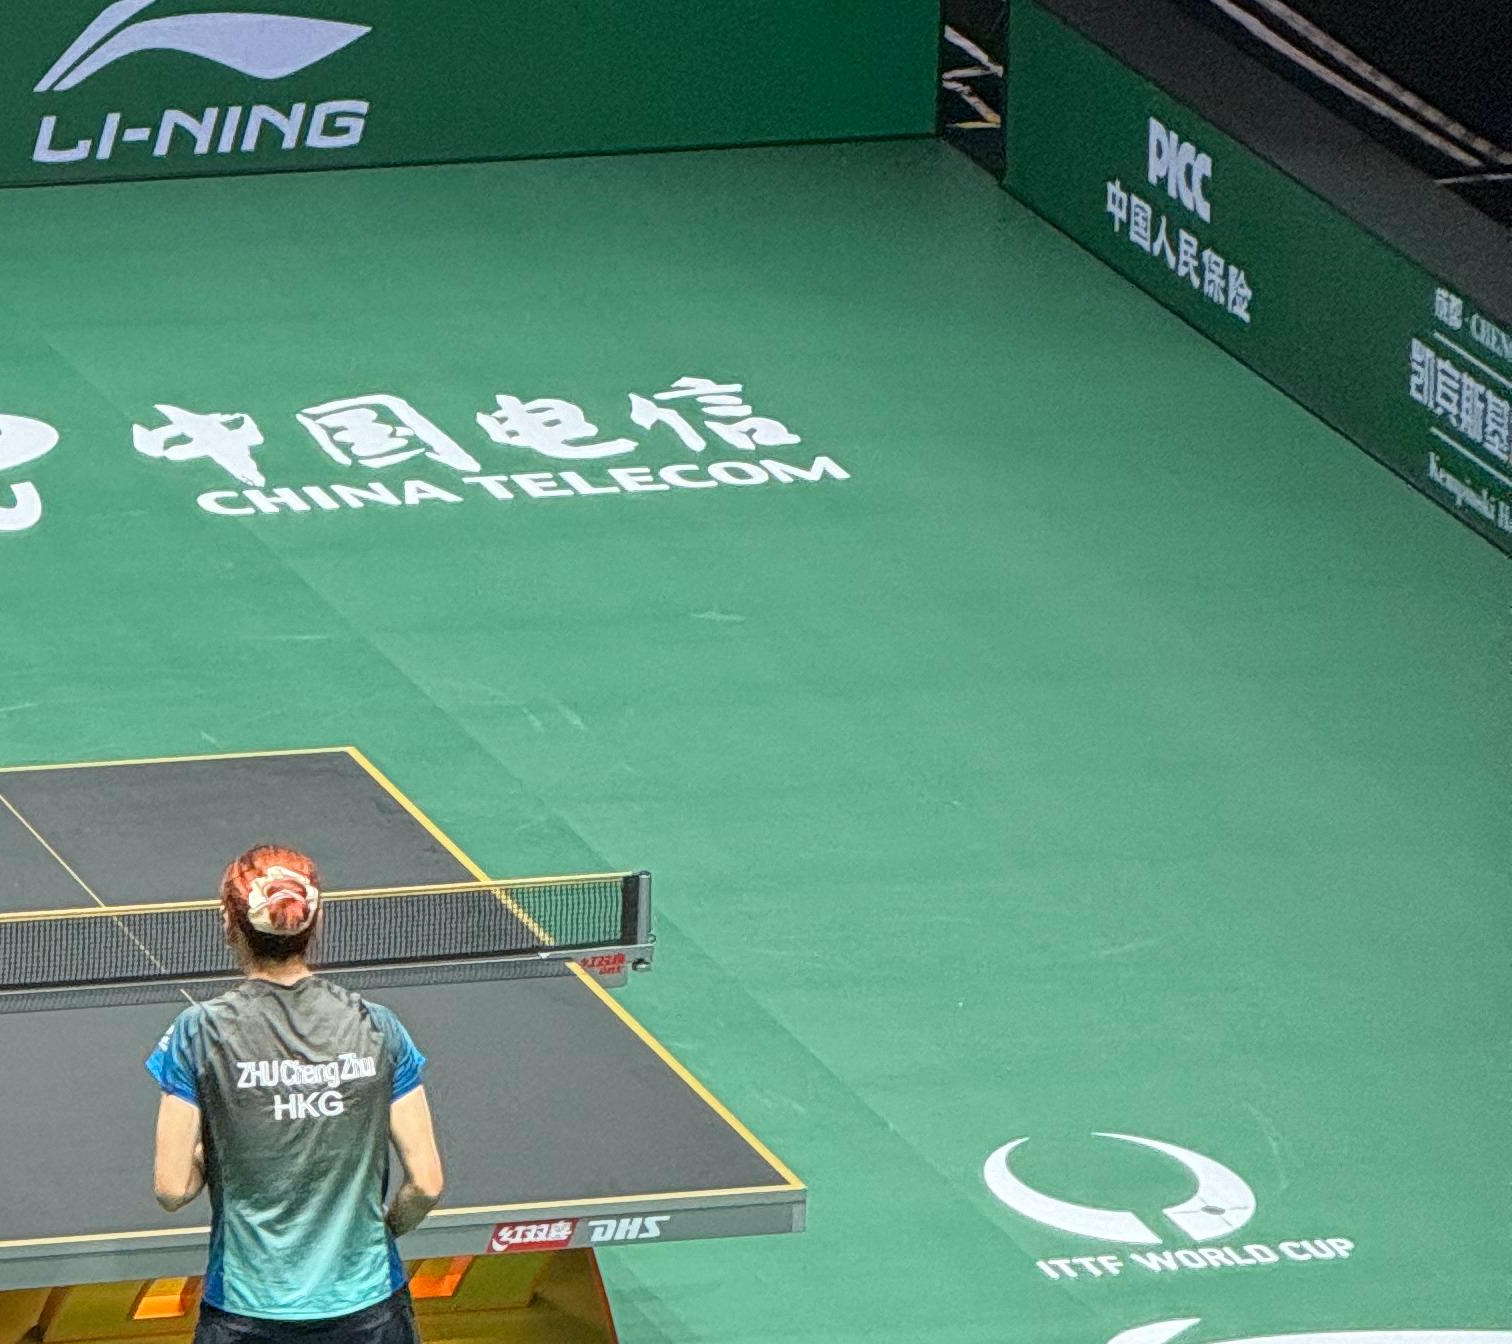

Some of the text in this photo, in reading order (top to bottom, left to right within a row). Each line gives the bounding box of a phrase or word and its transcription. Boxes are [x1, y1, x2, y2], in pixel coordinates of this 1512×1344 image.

[32, 99, 370, 164] LI-NING
[1147, 115, 1213, 225] PICC
[1106, 176, 1254, 325] 中国人民保险
[131, 376, 803, 488] 中国电信
[196, 455, 851, 517] CHINA TELECOM
[273, 1090, 345, 1121] HKG
[588, 1215, 671, 1242] DHS
[1036, 1237, 1356, 1281] ITTF WORLD CUP
